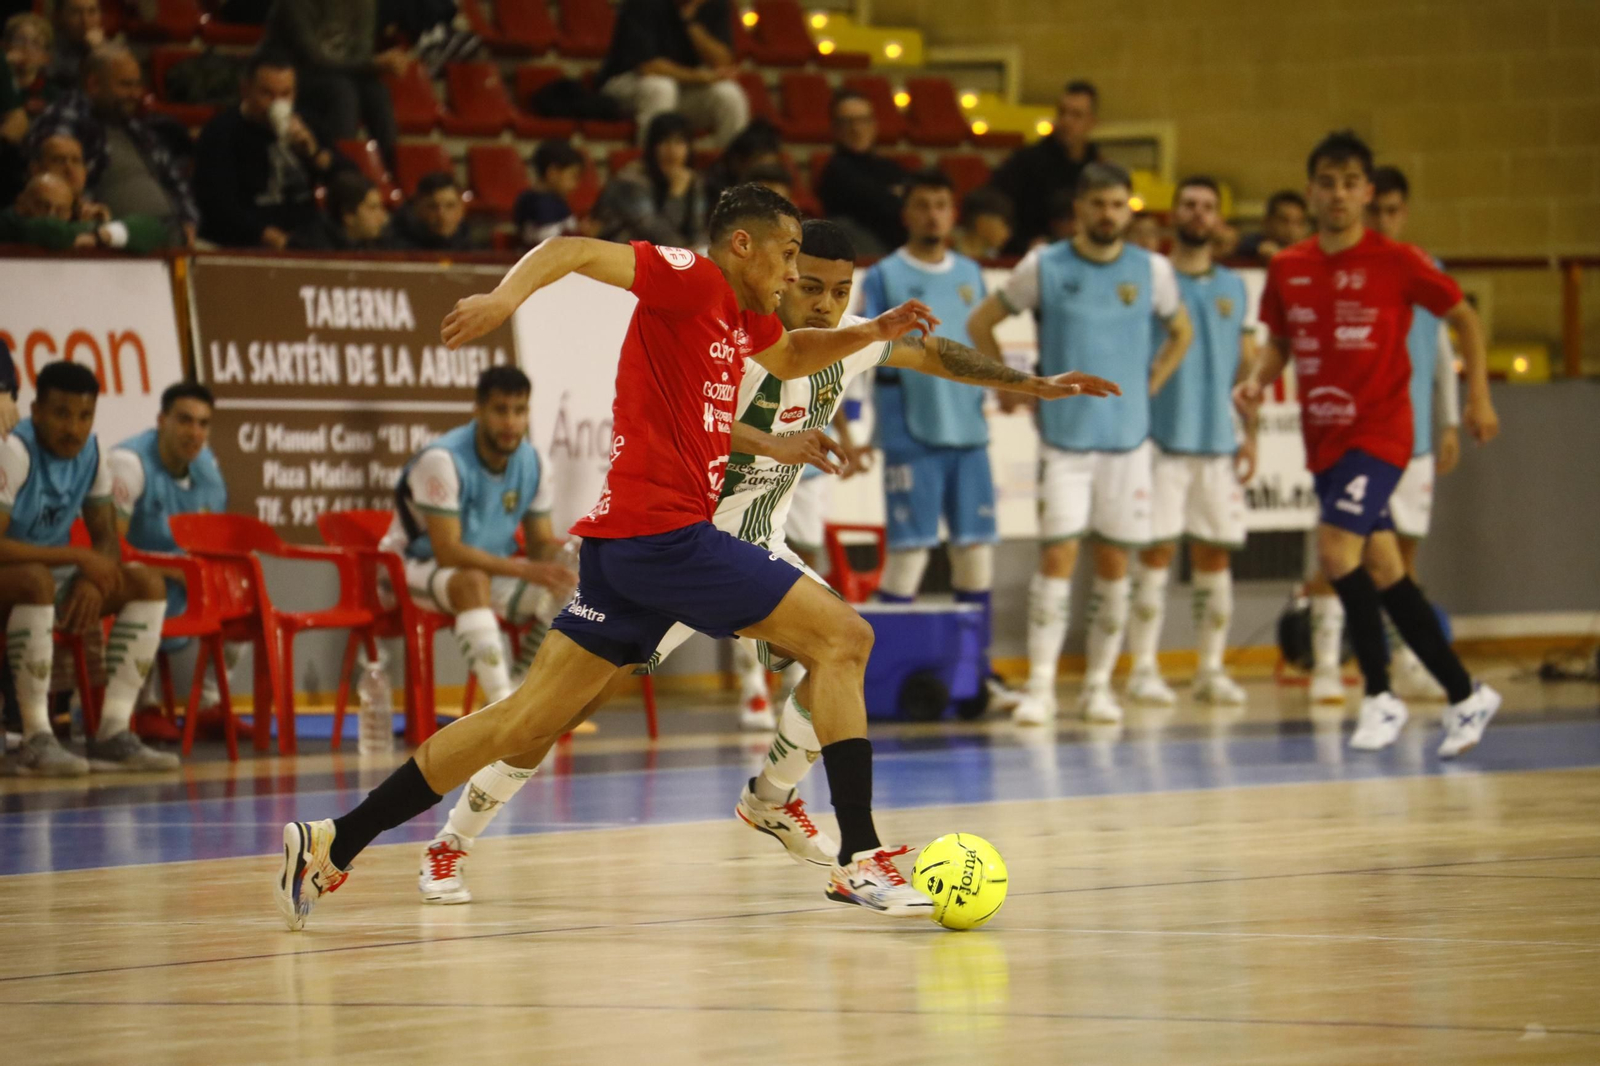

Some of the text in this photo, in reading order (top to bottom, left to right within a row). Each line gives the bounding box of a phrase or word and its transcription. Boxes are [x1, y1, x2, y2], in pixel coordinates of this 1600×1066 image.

[298, 285, 415, 331] TABERNA
[0, 328, 150, 395] can
[210, 340, 244, 385] LA
[248, 332, 340, 386] SARTÉN
[344, 344, 378, 386] DE
[382, 345, 416, 387] LA
[265, 423, 327, 453] Manuel
[330, 423, 374, 452] Cano
[263, 461, 306, 489] Plaza
[309, 459, 364, 489] Matías
[1344, 474, 1369, 502] 4
[567, 603, 606, 622] elektra
